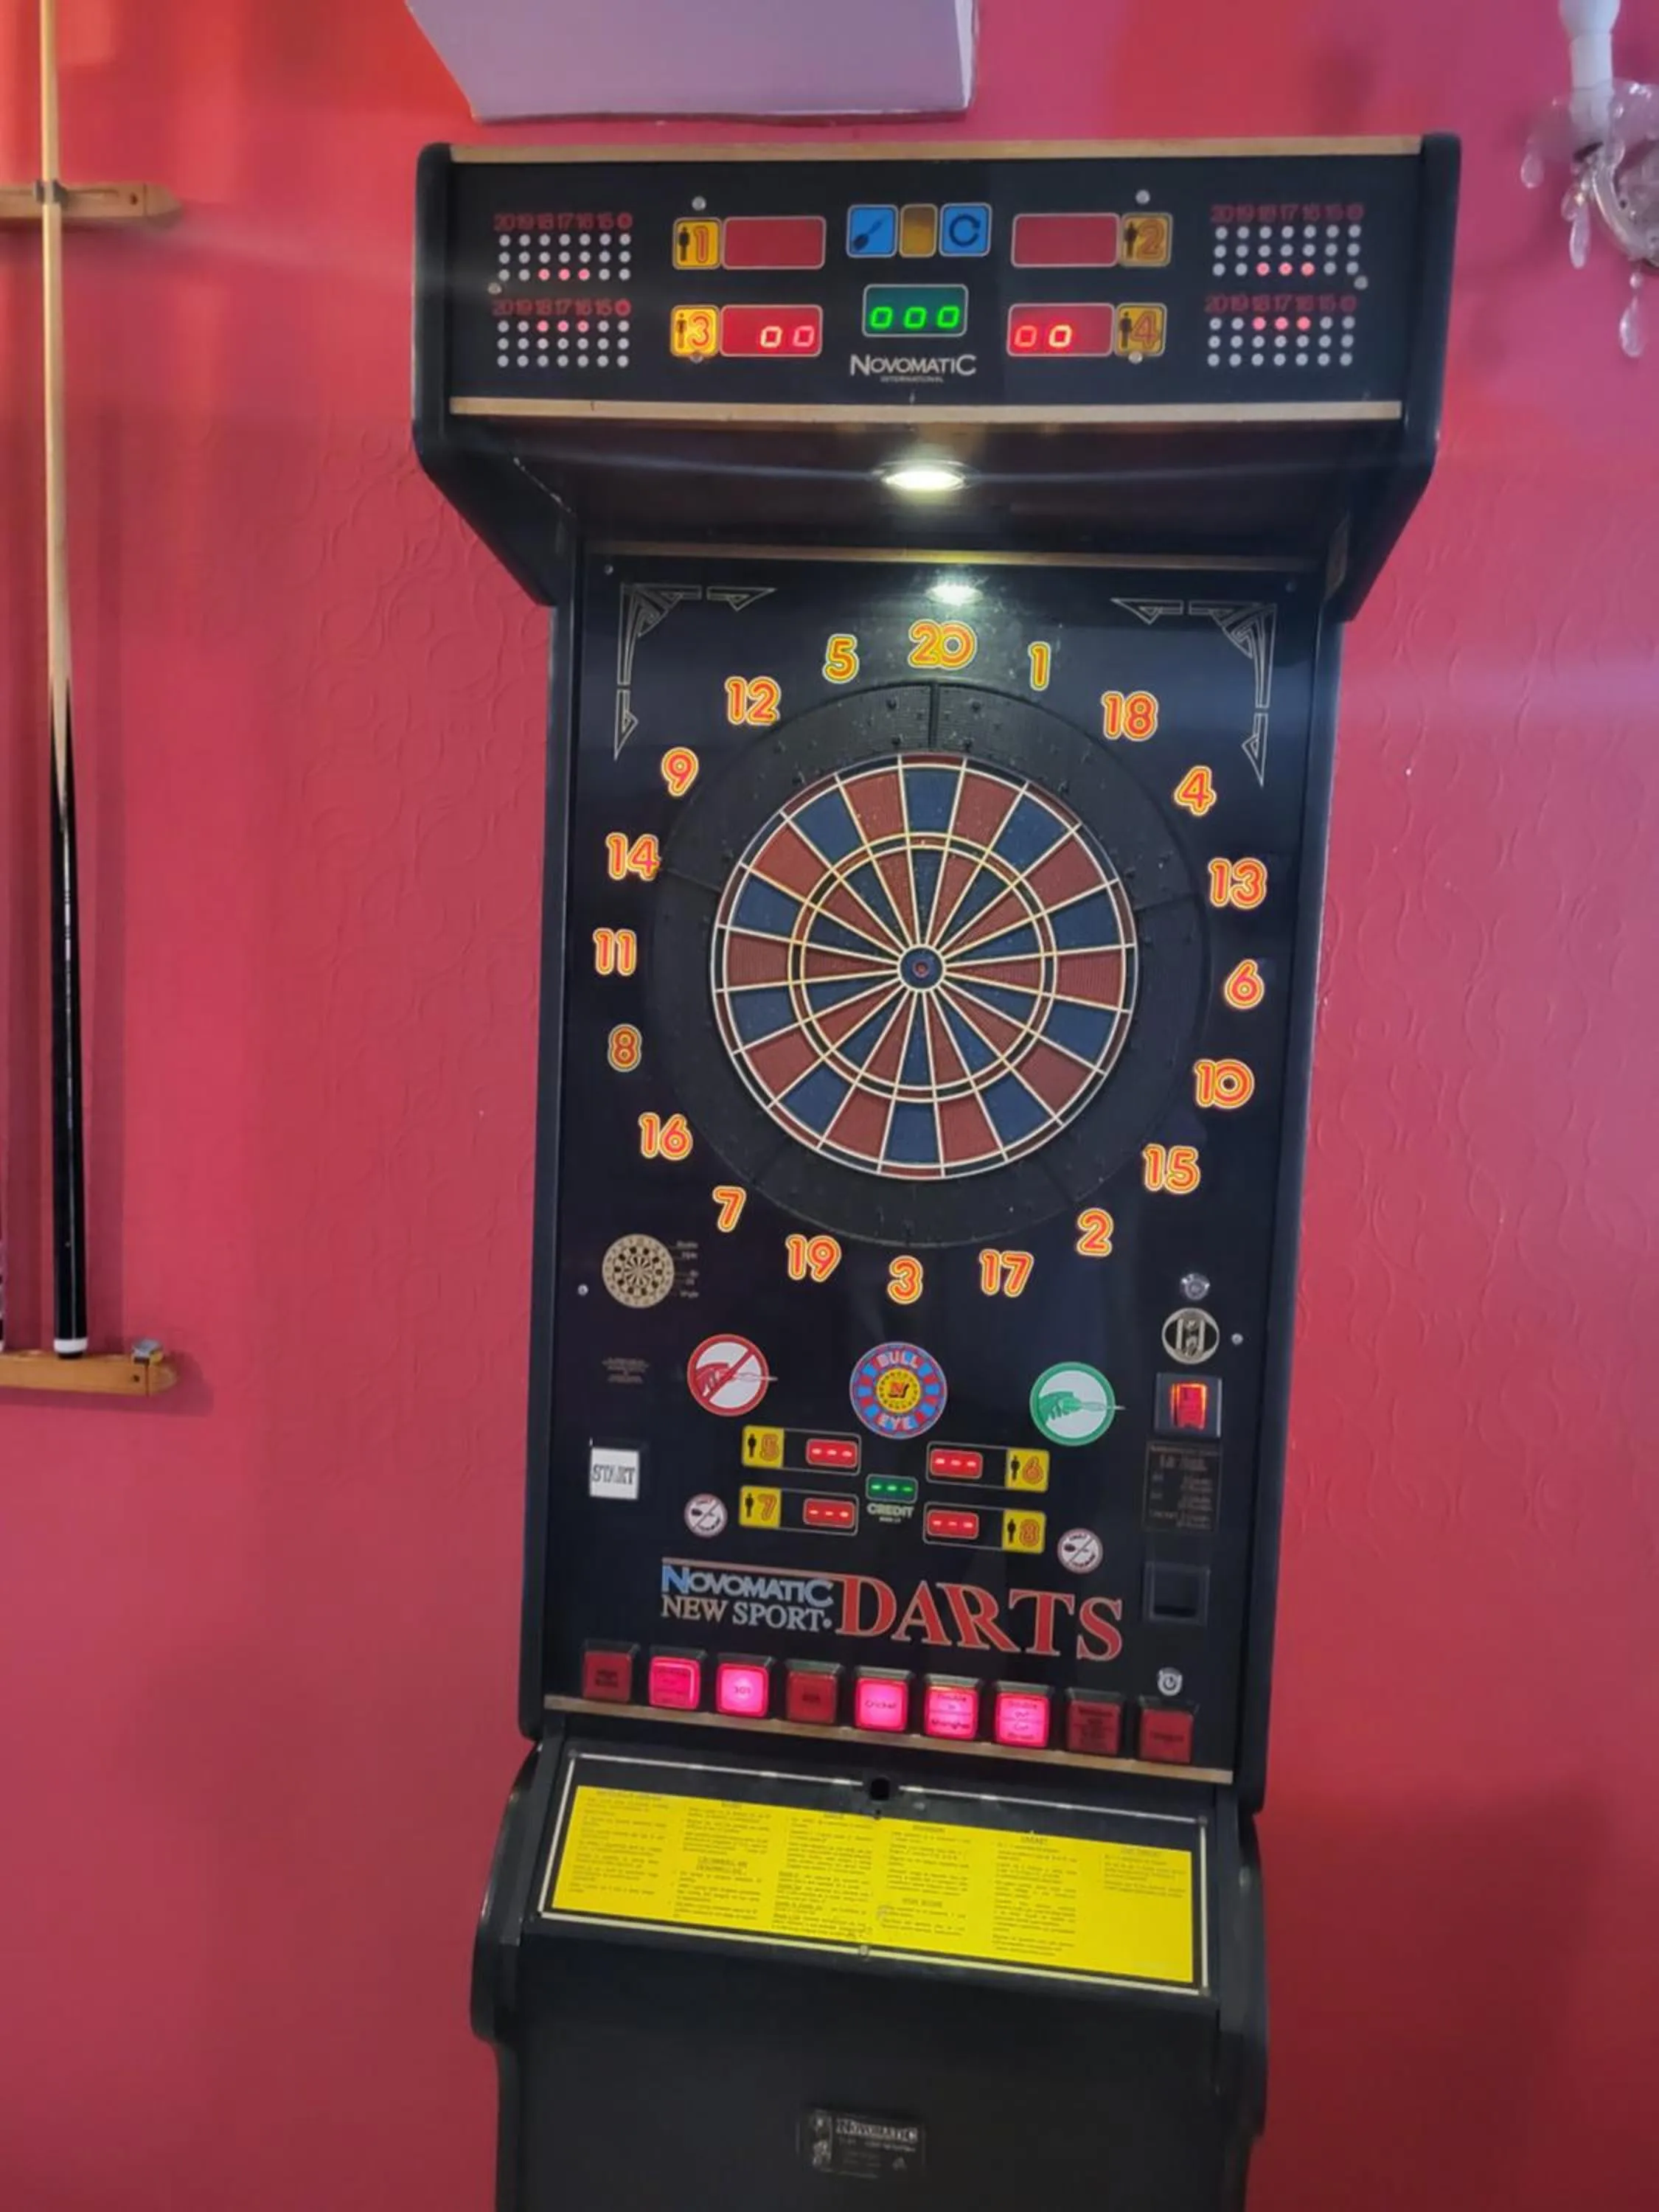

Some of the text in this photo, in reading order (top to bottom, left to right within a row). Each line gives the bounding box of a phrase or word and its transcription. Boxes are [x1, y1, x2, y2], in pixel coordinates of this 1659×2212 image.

[694, 225, 709, 263] 1
[1137, 219, 1164, 256] 2
[687, 311, 713, 347] 3
[1131, 310, 1158, 349] 4
[823, 633, 859, 683] 5
[909, 619, 976, 669] 20
[1029, 641, 1051, 690] 1
[725, 676, 781, 725] 12
[1102, 692, 1158, 740] 18
[661, 747, 699, 797] 9
[1174, 765, 1216, 815] 4
[606, 833, 660, 880] 14
[1208, 858, 1267, 908] 13
[594, 928, 636, 975] 11
[1224, 959, 1264, 1009] 6
[608, 1024, 642, 1072] 8
[1194, 1059, 1255, 1109] 10
[639, 1113, 693, 1161] 16
[1143, 1144, 1200, 1194] 15
[712, 1186, 746, 1232] 7
[1076, 1208, 1114, 1256] 2
[785, 1234, 841, 1282] 19
[887, 1256, 922, 1304] 3
[979, 1249, 1033, 1296] 17
[591, 1464, 636, 1485] START
[757, 1494, 778, 1522] 7
[866, 1502, 915, 1519] CREDIT
[661, 1594, 728, 1622] NEW
[835, 1575, 1123, 1661] DARTS
